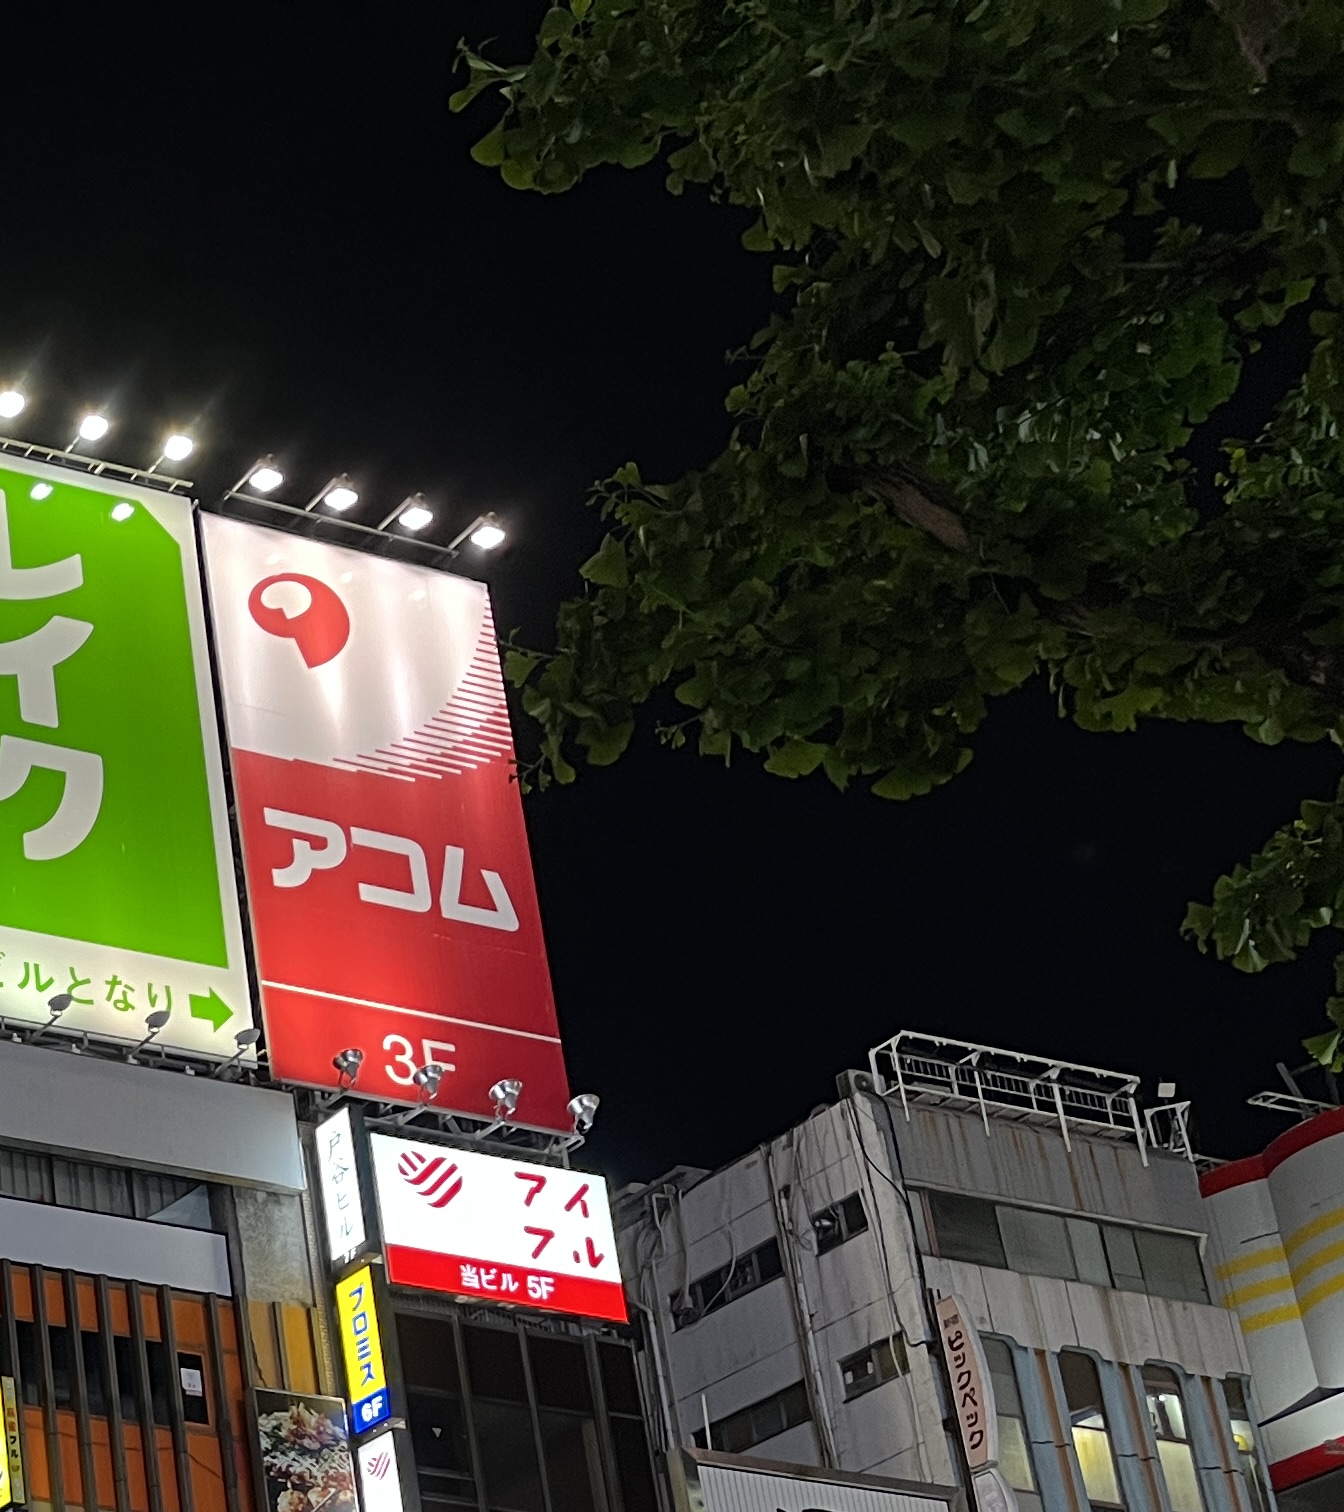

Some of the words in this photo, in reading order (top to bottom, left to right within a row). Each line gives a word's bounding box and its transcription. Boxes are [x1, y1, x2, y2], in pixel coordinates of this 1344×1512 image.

[262, 806, 520, 933] アコム
[382, 1032, 457, 1088] 3F
[327, 1129, 355, 1241] 戸谷ビル
[460, 1262, 520, 1294] 当ビル
[526, 1274, 556, 1301] 5F
[348, 1281, 377, 1388] プロミス
[360, 1394, 385, 1423] 6F
